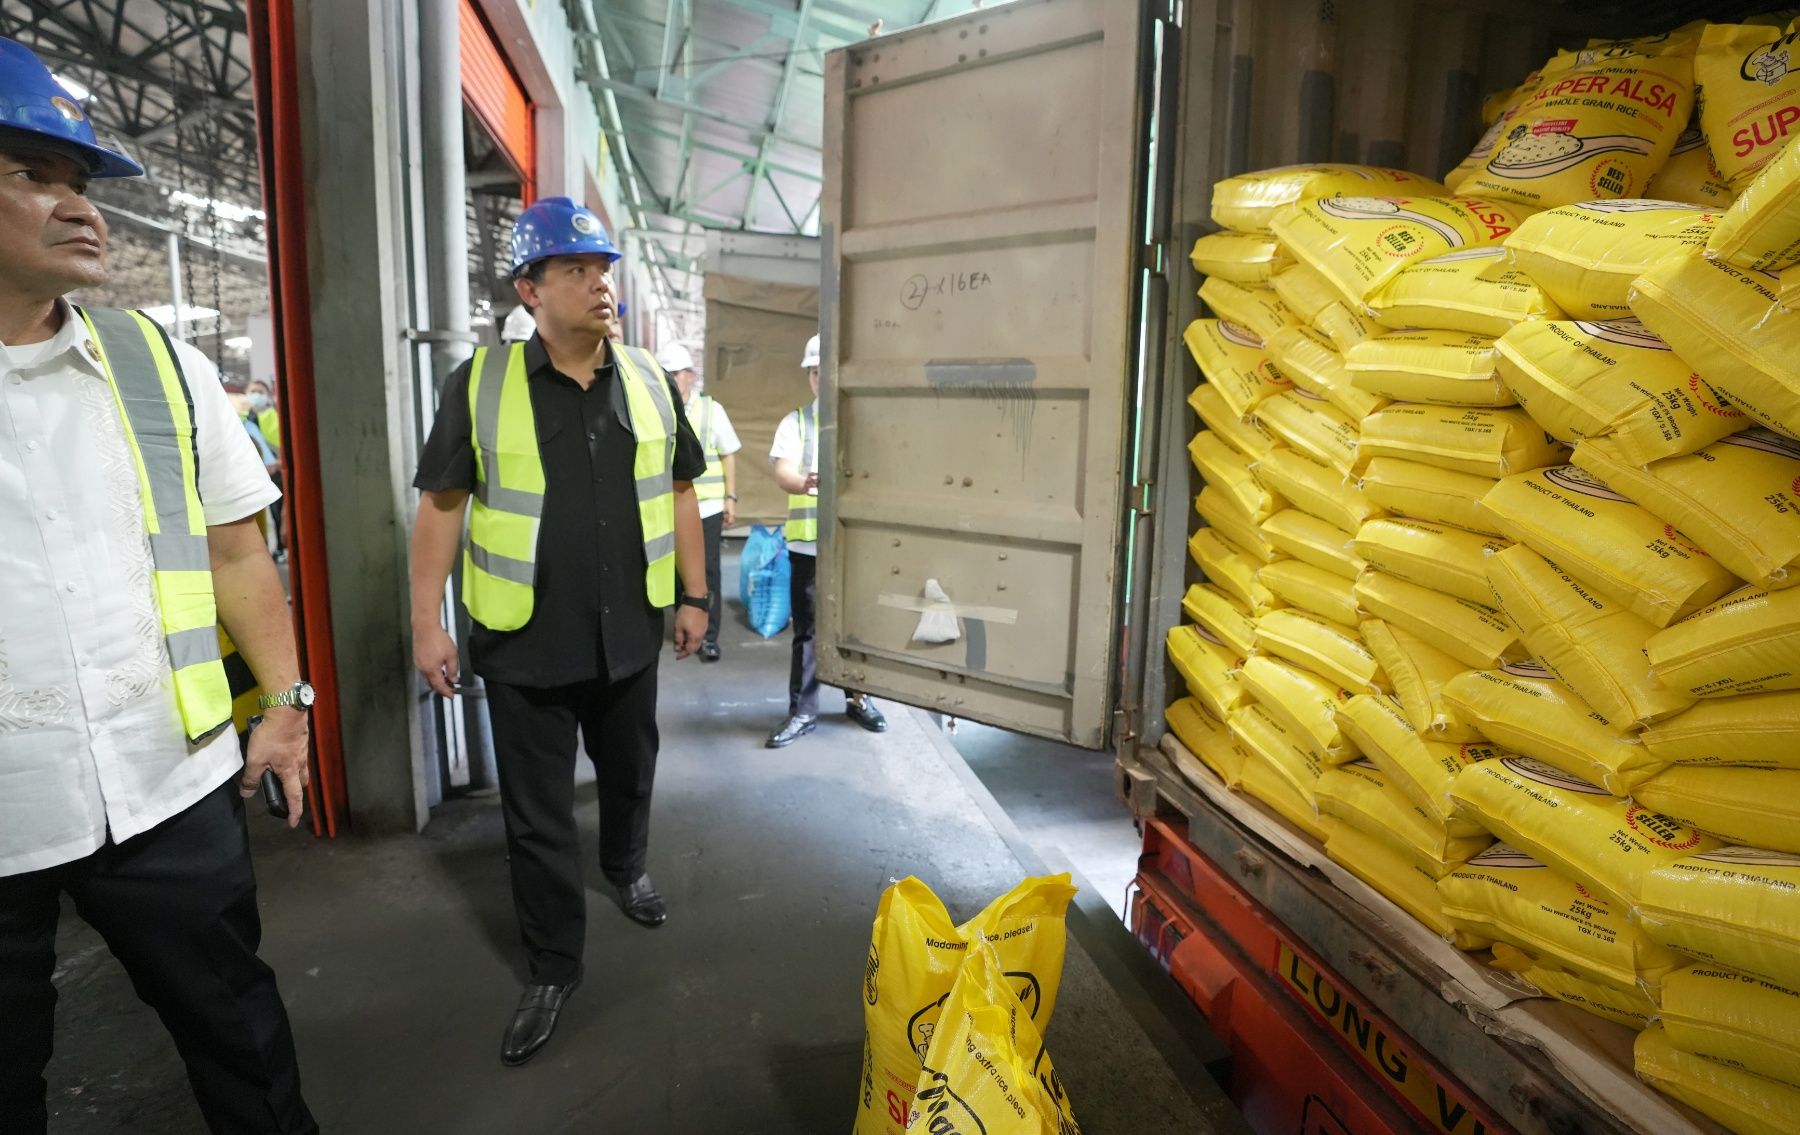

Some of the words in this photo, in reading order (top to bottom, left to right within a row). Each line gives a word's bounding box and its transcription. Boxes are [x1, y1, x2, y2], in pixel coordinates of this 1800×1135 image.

[1592, 67, 1638, 75] EMIUM
[1610, 76, 1677, 117] ALSA
[1545, 98, 1583, 107] WHOLE
[1582, 98, 1614, 110] GRAIN
[1615, 105, 1639, 118] RICE
[1732, 105, 1800, 158] SUP
[1606, 166, 1625, 182] BEST
[1475, 180, 1500, 192] PRODUCT
[1501, 185, 1511, 194] OF
[1511, 188, 1541, 200] THAILAND
[1597, 176, 1624, 196] SELLER
[1700, 185, 1718, 197] 25kg
[1592, 218, 1626, 228] THAILAND
[1384, 233, 1407, 252] SELLER
[1397, 230, 1416, 244] BEST
[1740, 274, 1754, 285] OF
[1752, 283, 1780, 302] THAIL
[1547, 322, 1577, 344] PRODUCT
[1573, 339, 1586, 351] OF
[1582, 344, 1617, 367] THAILAND
[1661, 390, 1681, 410] 25kg
[1673, 387, 1683, 398] Net
[1682, 398, 1698, 417] Weight
[1462, 414, 1479, 422] 25kg
[1649, 407, 1662, 422] TGX
[1668, 416, 1681, 438] BROKEN
[1522, 479, 1554, 499] PRODUCT
[1551, 492, 1562, 502] OF
[1561, 497, 1595, 519] THAILAND
[1764, 495, 1789, 514] 25kg
[1646, 541, 1671, 560] 25kg
[1654, 538, 1666, 549] Net
[1664, 545, 1691, 561] Weight
[1559, 574, 1572, 589] OF
[1569, 583, 1603, 610] THAILAND
[1721, 592, 1769, 609] THAILAND
[1473, 671, 1501, 685] PRODUCT
[1512, 683, 1542, 698] THAILAND
[1441, 757, 1455, 773] 25kg
[1481, 767, 1515, 787] PRODUCT
[1513, 782, 1524, 792] OF
[1524, 787, 1559, 809] THAILAND
[1634, 812, 1676, 842] SELLER
[1609, 832, 1632, 853] 25kg
[1616, 829, 1630, 841] Net
[1627, 835, 1651, 856] Weight
[1451, 872, 1477, 881] PRODUCT
[1477, 874, 1485, 882] OF
[1485, 875, 1518, 892] THAILAND
[1672, 863, 1721, 876] PRODUCT
[1722, 868, 1738, 878] OF
[1740, 872, 1797, 891] THAILAND
[1569, 904, 1593, 919] 25kg
[1573, 899, 1585, 907] Net
[1587, 903, 1609, 916] Weight
[1003, 923, 1034, 941] please!
[1570, 916, 1583, 924] RICE
[1593, 924, 1617, 936] BROKEN
[1578, 925, 1592, 936] TGX
[1691, 968, 1738, 981] PRODUCT
[1741, 975, 1754, 984] OF
[1289, 953, 1409, 1084] LONG
[975, 1049, 998, 1077] extra
[994, 1071, 1009, 1097] rice,
[1005, 1092, 1027, 1119] pleas
